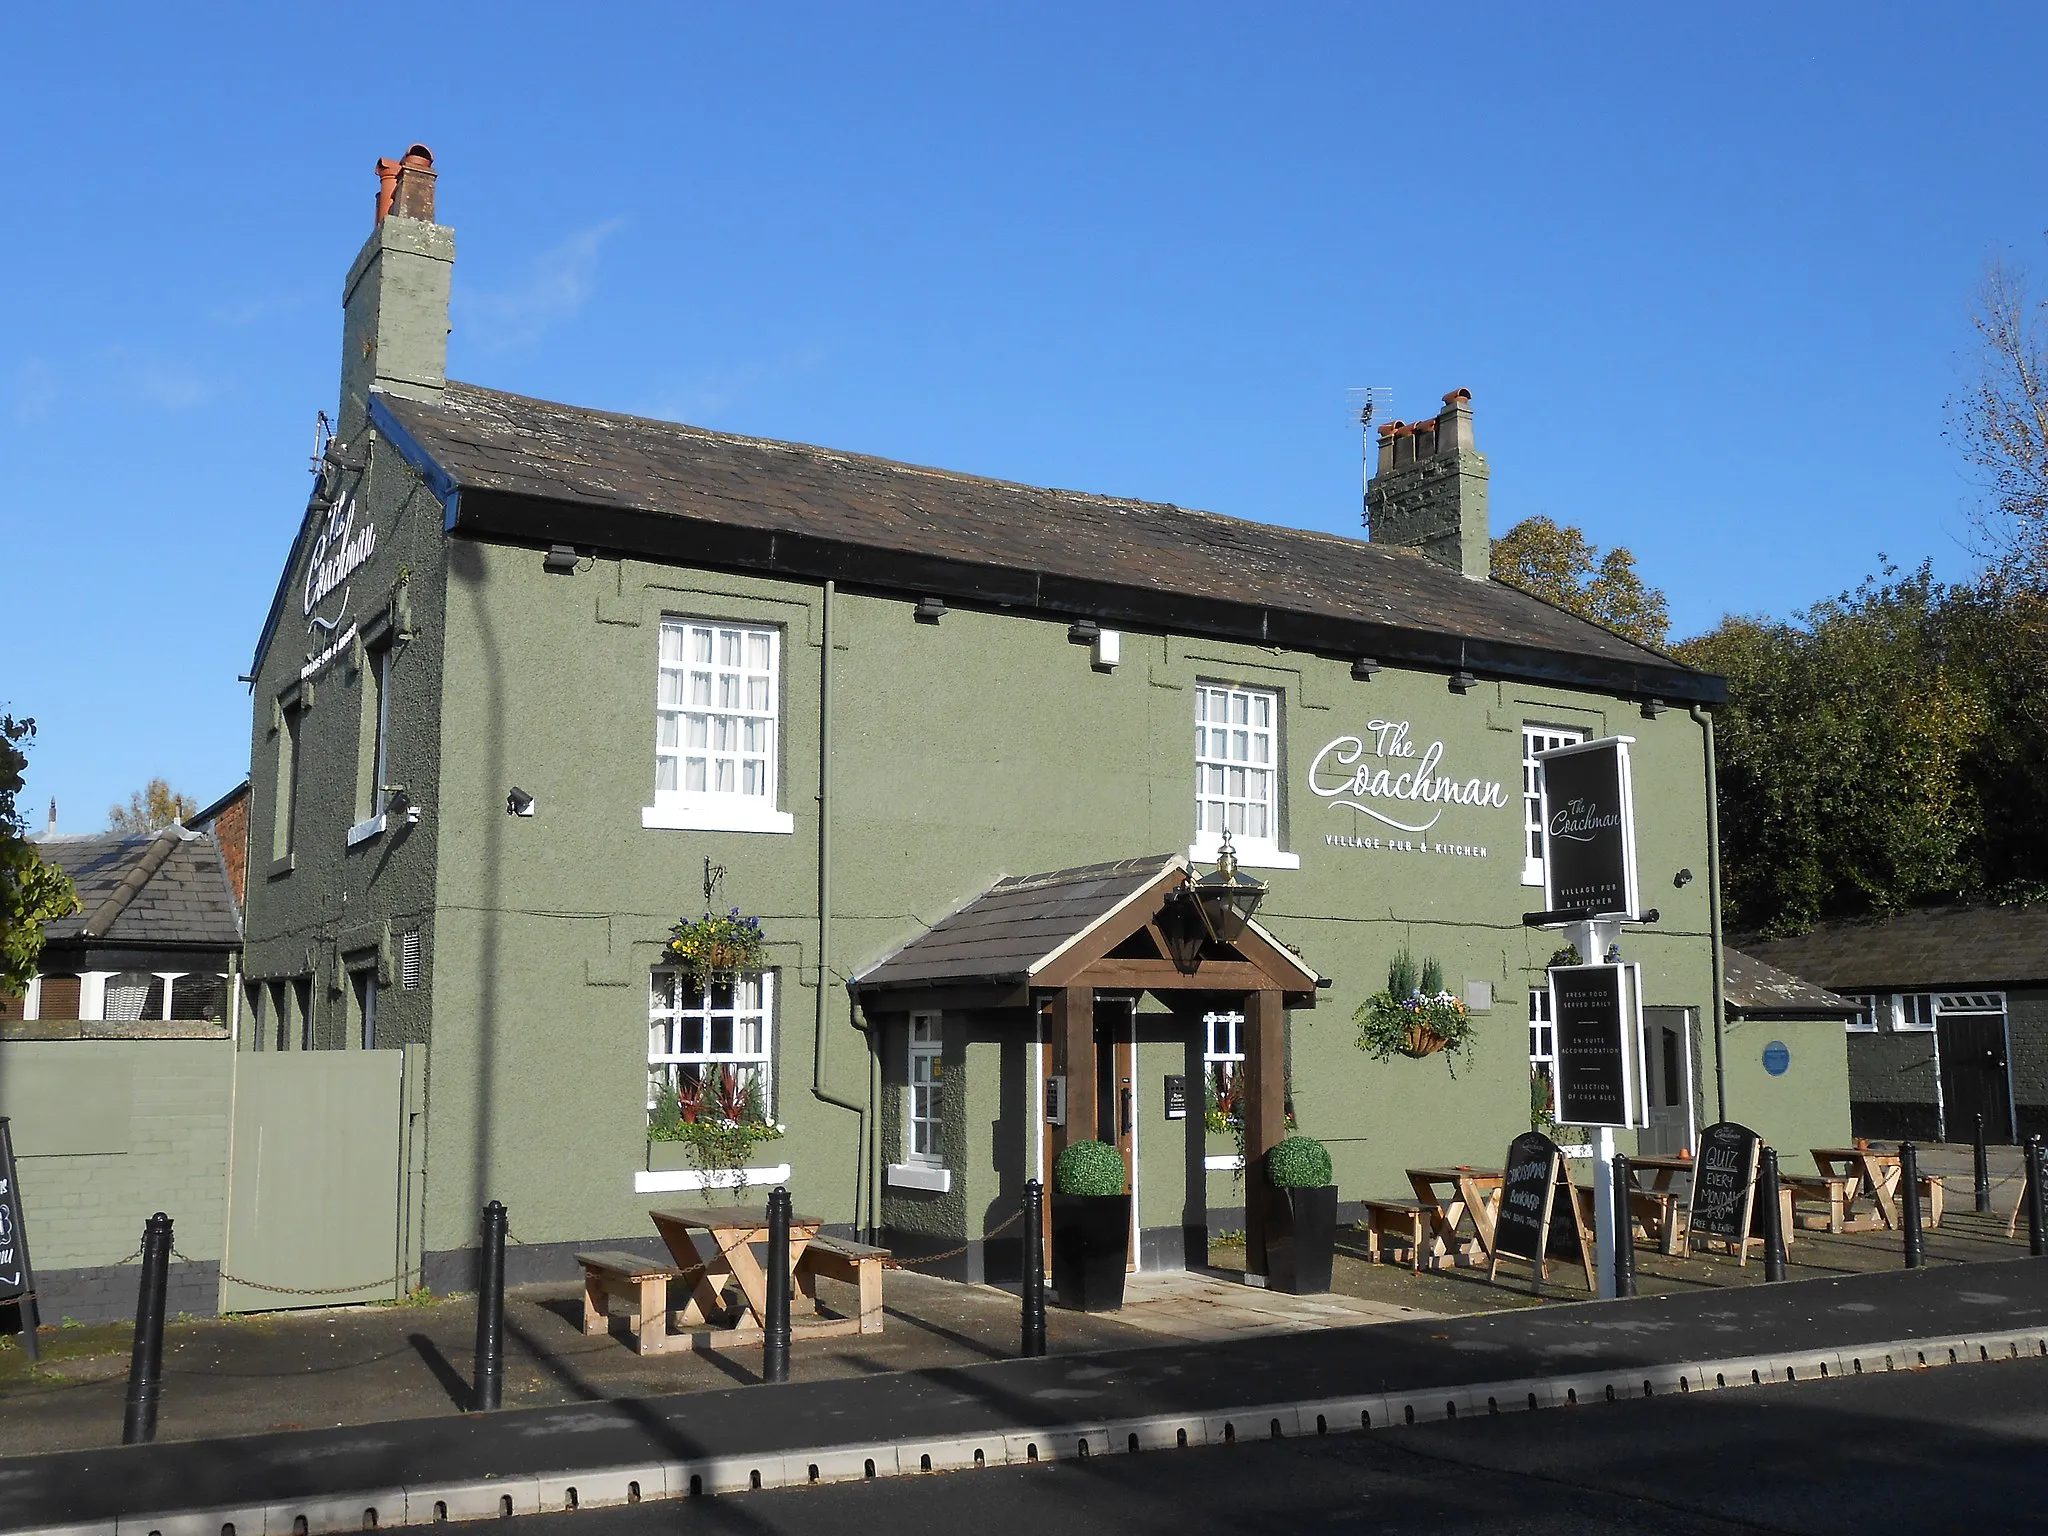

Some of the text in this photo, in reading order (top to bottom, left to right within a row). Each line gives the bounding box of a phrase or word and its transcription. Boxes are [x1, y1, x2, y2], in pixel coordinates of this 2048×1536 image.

[304, 499, 376, 616] Coachman
[1366, 719, 1415, 758] The
[1307, 735, 1509, 809] Coachman
[1567, 797, 1586, 816] The
[1549, 803, 1621, 836] Coachman
[1325, 834, 1488, 858] VILLAGE PUB & KITCHEN
[1560, 883, 1617, 896] VILLAGE PUB
[1576, 897, 1612, 907] KITCHEN
[1563, 1001, 1588, 1009] SERVED
[1579, 1093, 1597, 1101] CASK
[1706, 1172, 1734, 1189] EVERY
[1700, 1188, 1739, 1208] MONDAY
